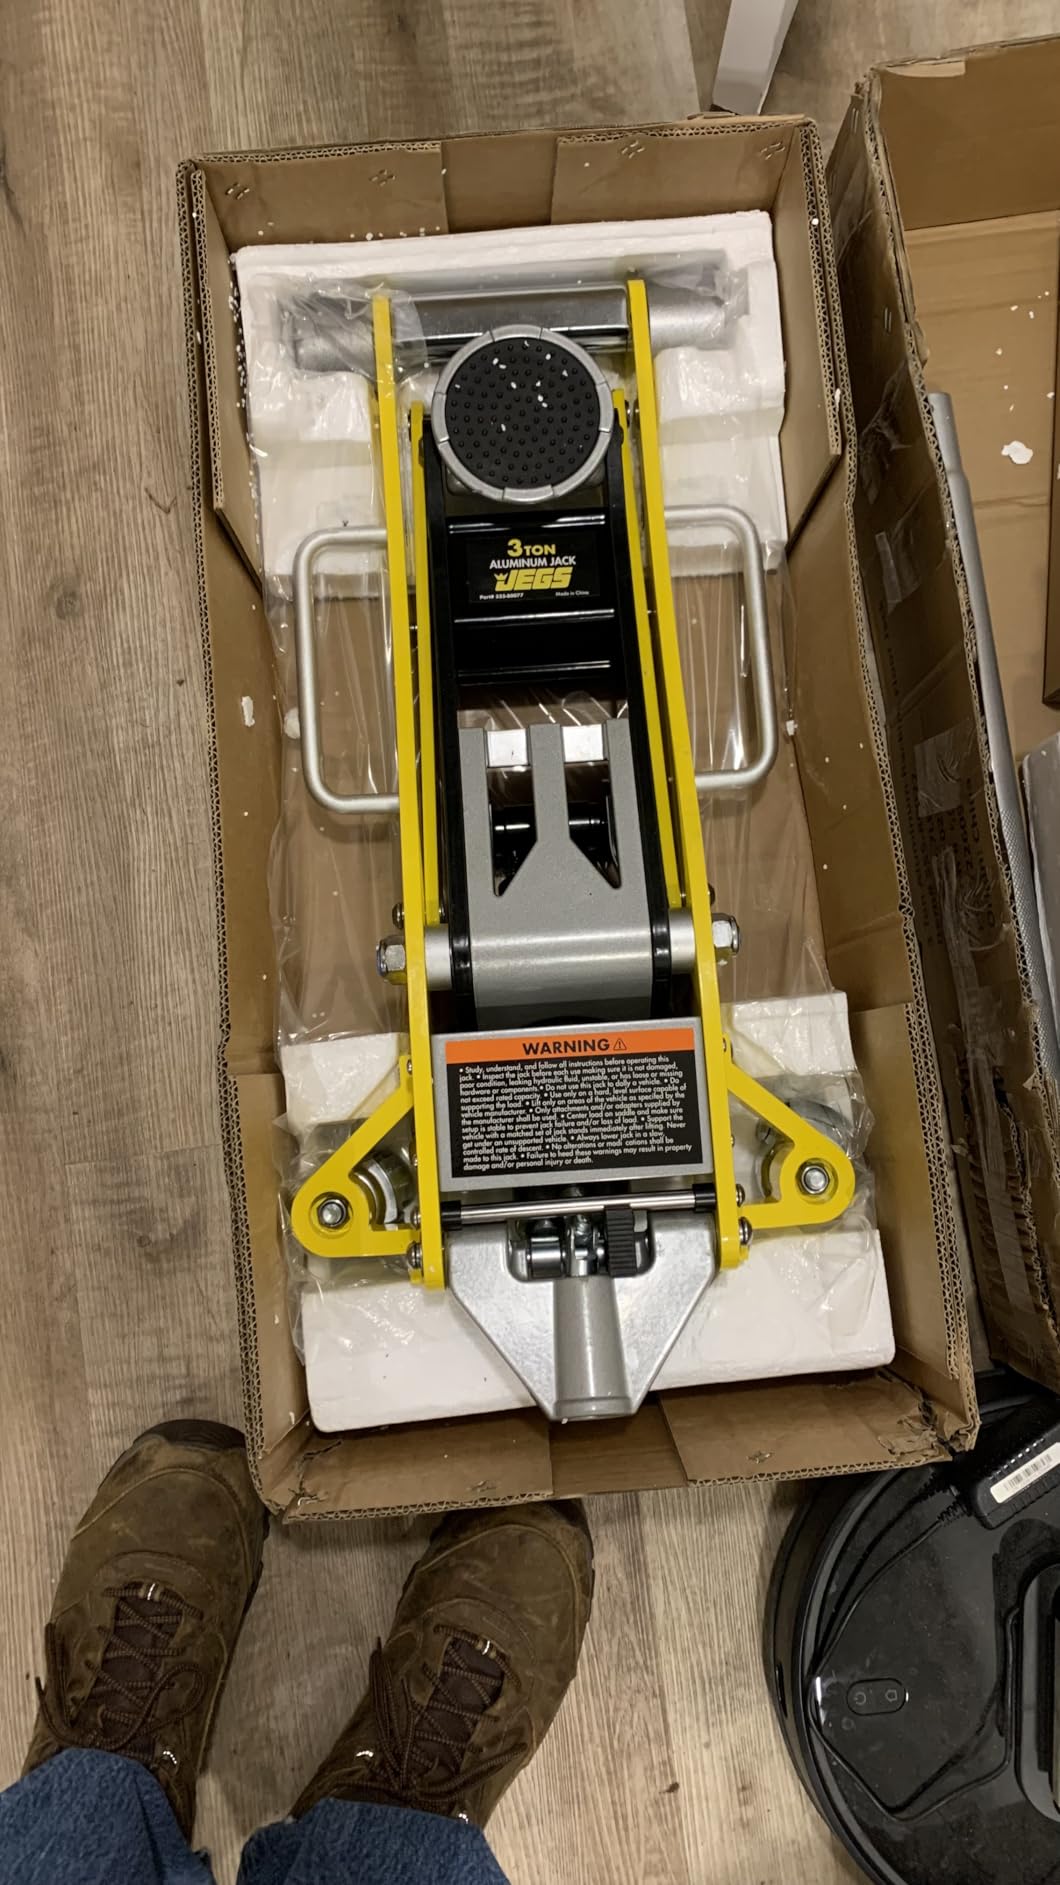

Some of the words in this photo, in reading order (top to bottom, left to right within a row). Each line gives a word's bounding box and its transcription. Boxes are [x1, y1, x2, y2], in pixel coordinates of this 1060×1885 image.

[507, 538, 523, 557] 3
[523, 544, 556, 556] TON
[489, 557, 548, 569] ALUMINUM
[549, 555, 576, 566] JACK
[494, 566, 573, 592] JEGS
[523, 1038, 610, 1055] WARNING
